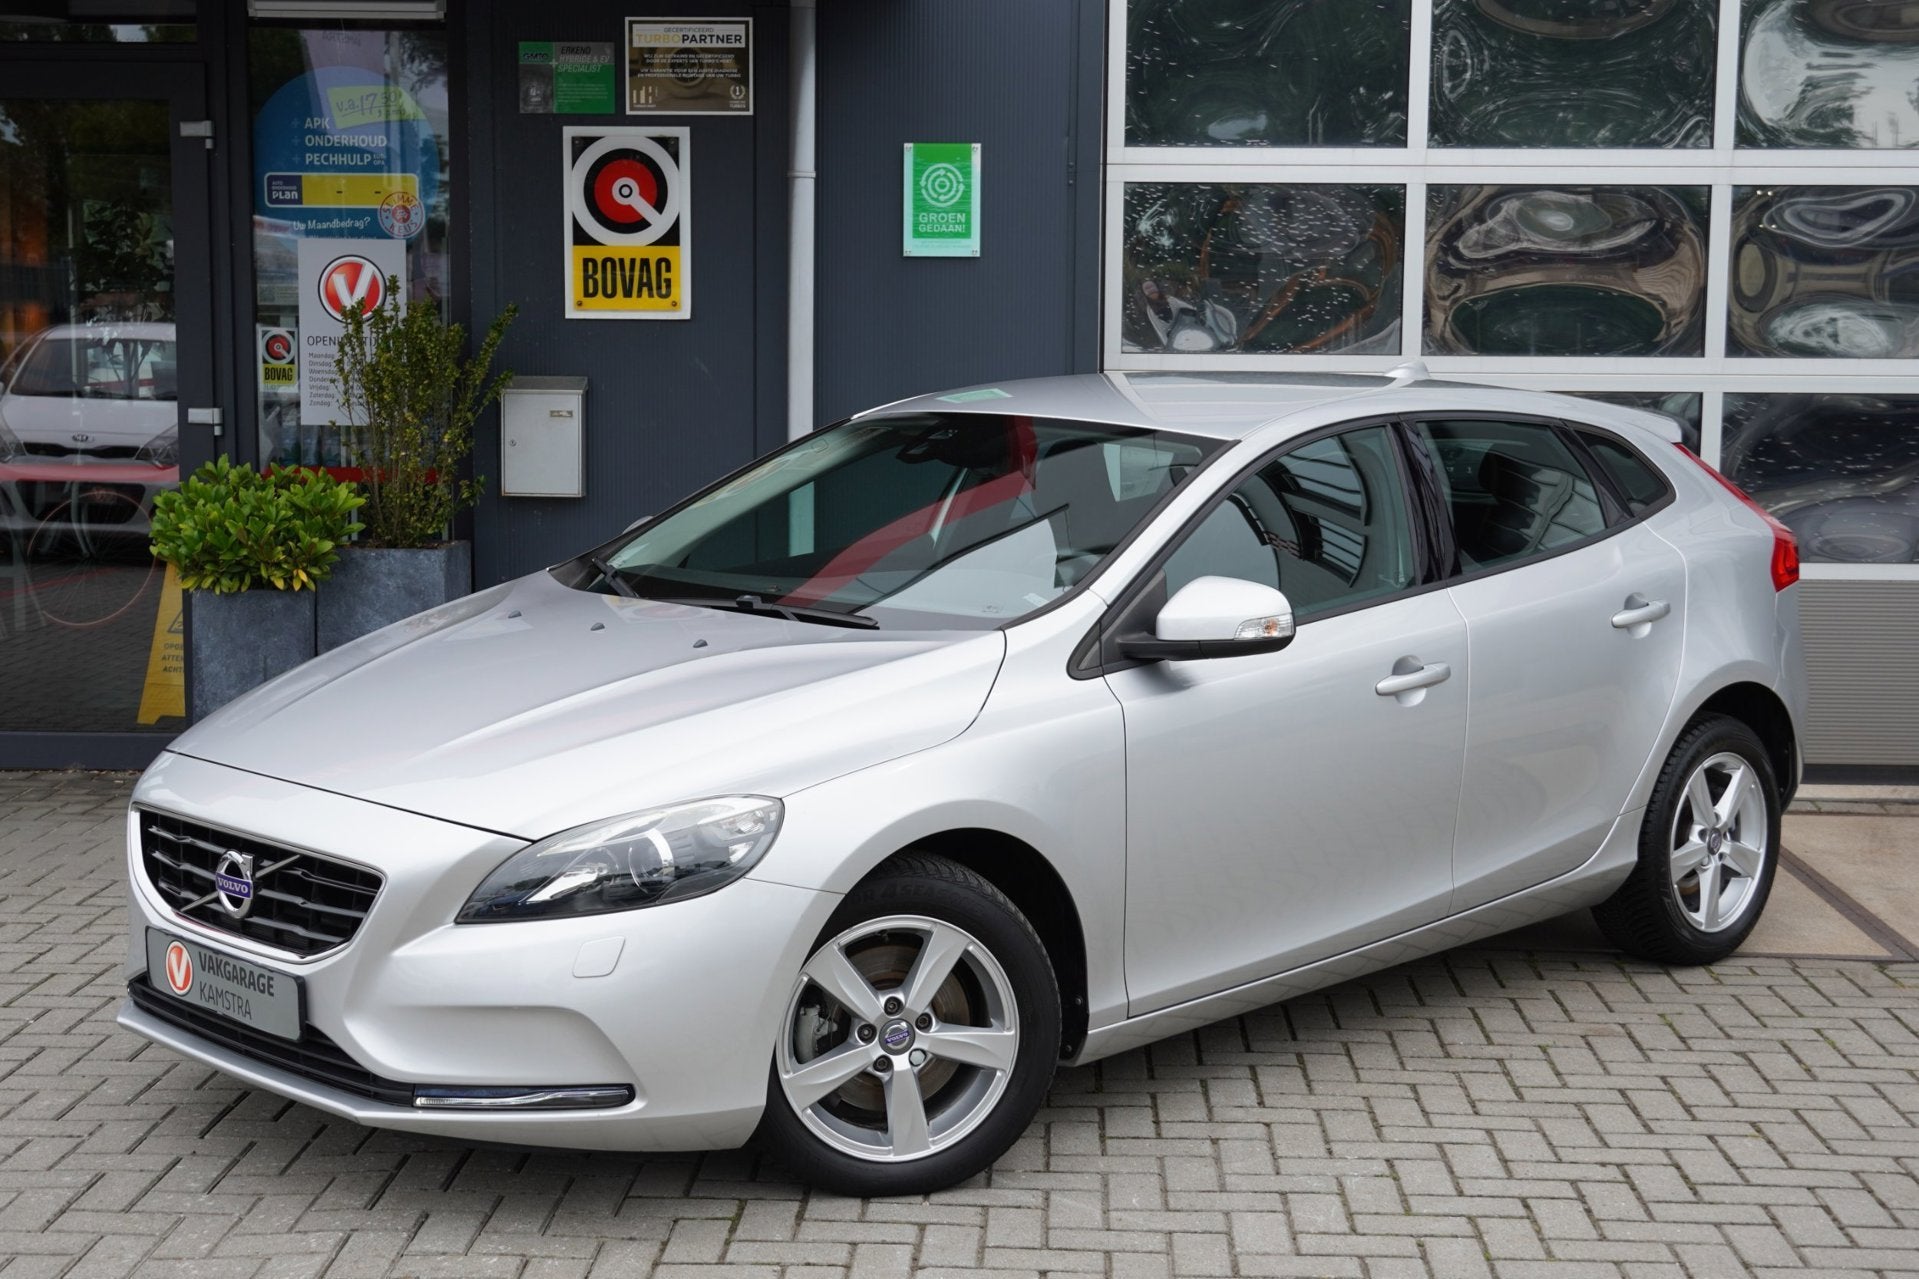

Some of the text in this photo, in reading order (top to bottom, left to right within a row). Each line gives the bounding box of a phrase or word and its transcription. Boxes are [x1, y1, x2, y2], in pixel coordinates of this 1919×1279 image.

[560, 46, 592, 55] ERKEND
[559, 55, 591, 63] HYBRIDE
[600, 55, 611, 63] EV
[557, 63, 602, 73] SPECIALIST
[304, 117, 330, 130] APK
[304, 134, 388, 147] ONDERHOUD
[305, 152, 372, 166] PECHHULP
[293, 220, 306, 231] Uw
[307, 217, 371, 231] Maandbedrag?
[919, 212, 966, 223] GROEN
[389, 221, 418, 236] KEUS
[918, 223, 966, 233] GEDAAN!
[582, 256, 672, 299] BOVAG
[264, 367, 293, 381] BOVAG
[216, 876, 249, 894] VOLVO
[198, 950, 275, 997] VAKGARAGE
[199, 981, 252, 1021] KAMSTRA
[886, 1032, 909, 1043] VOLVO
